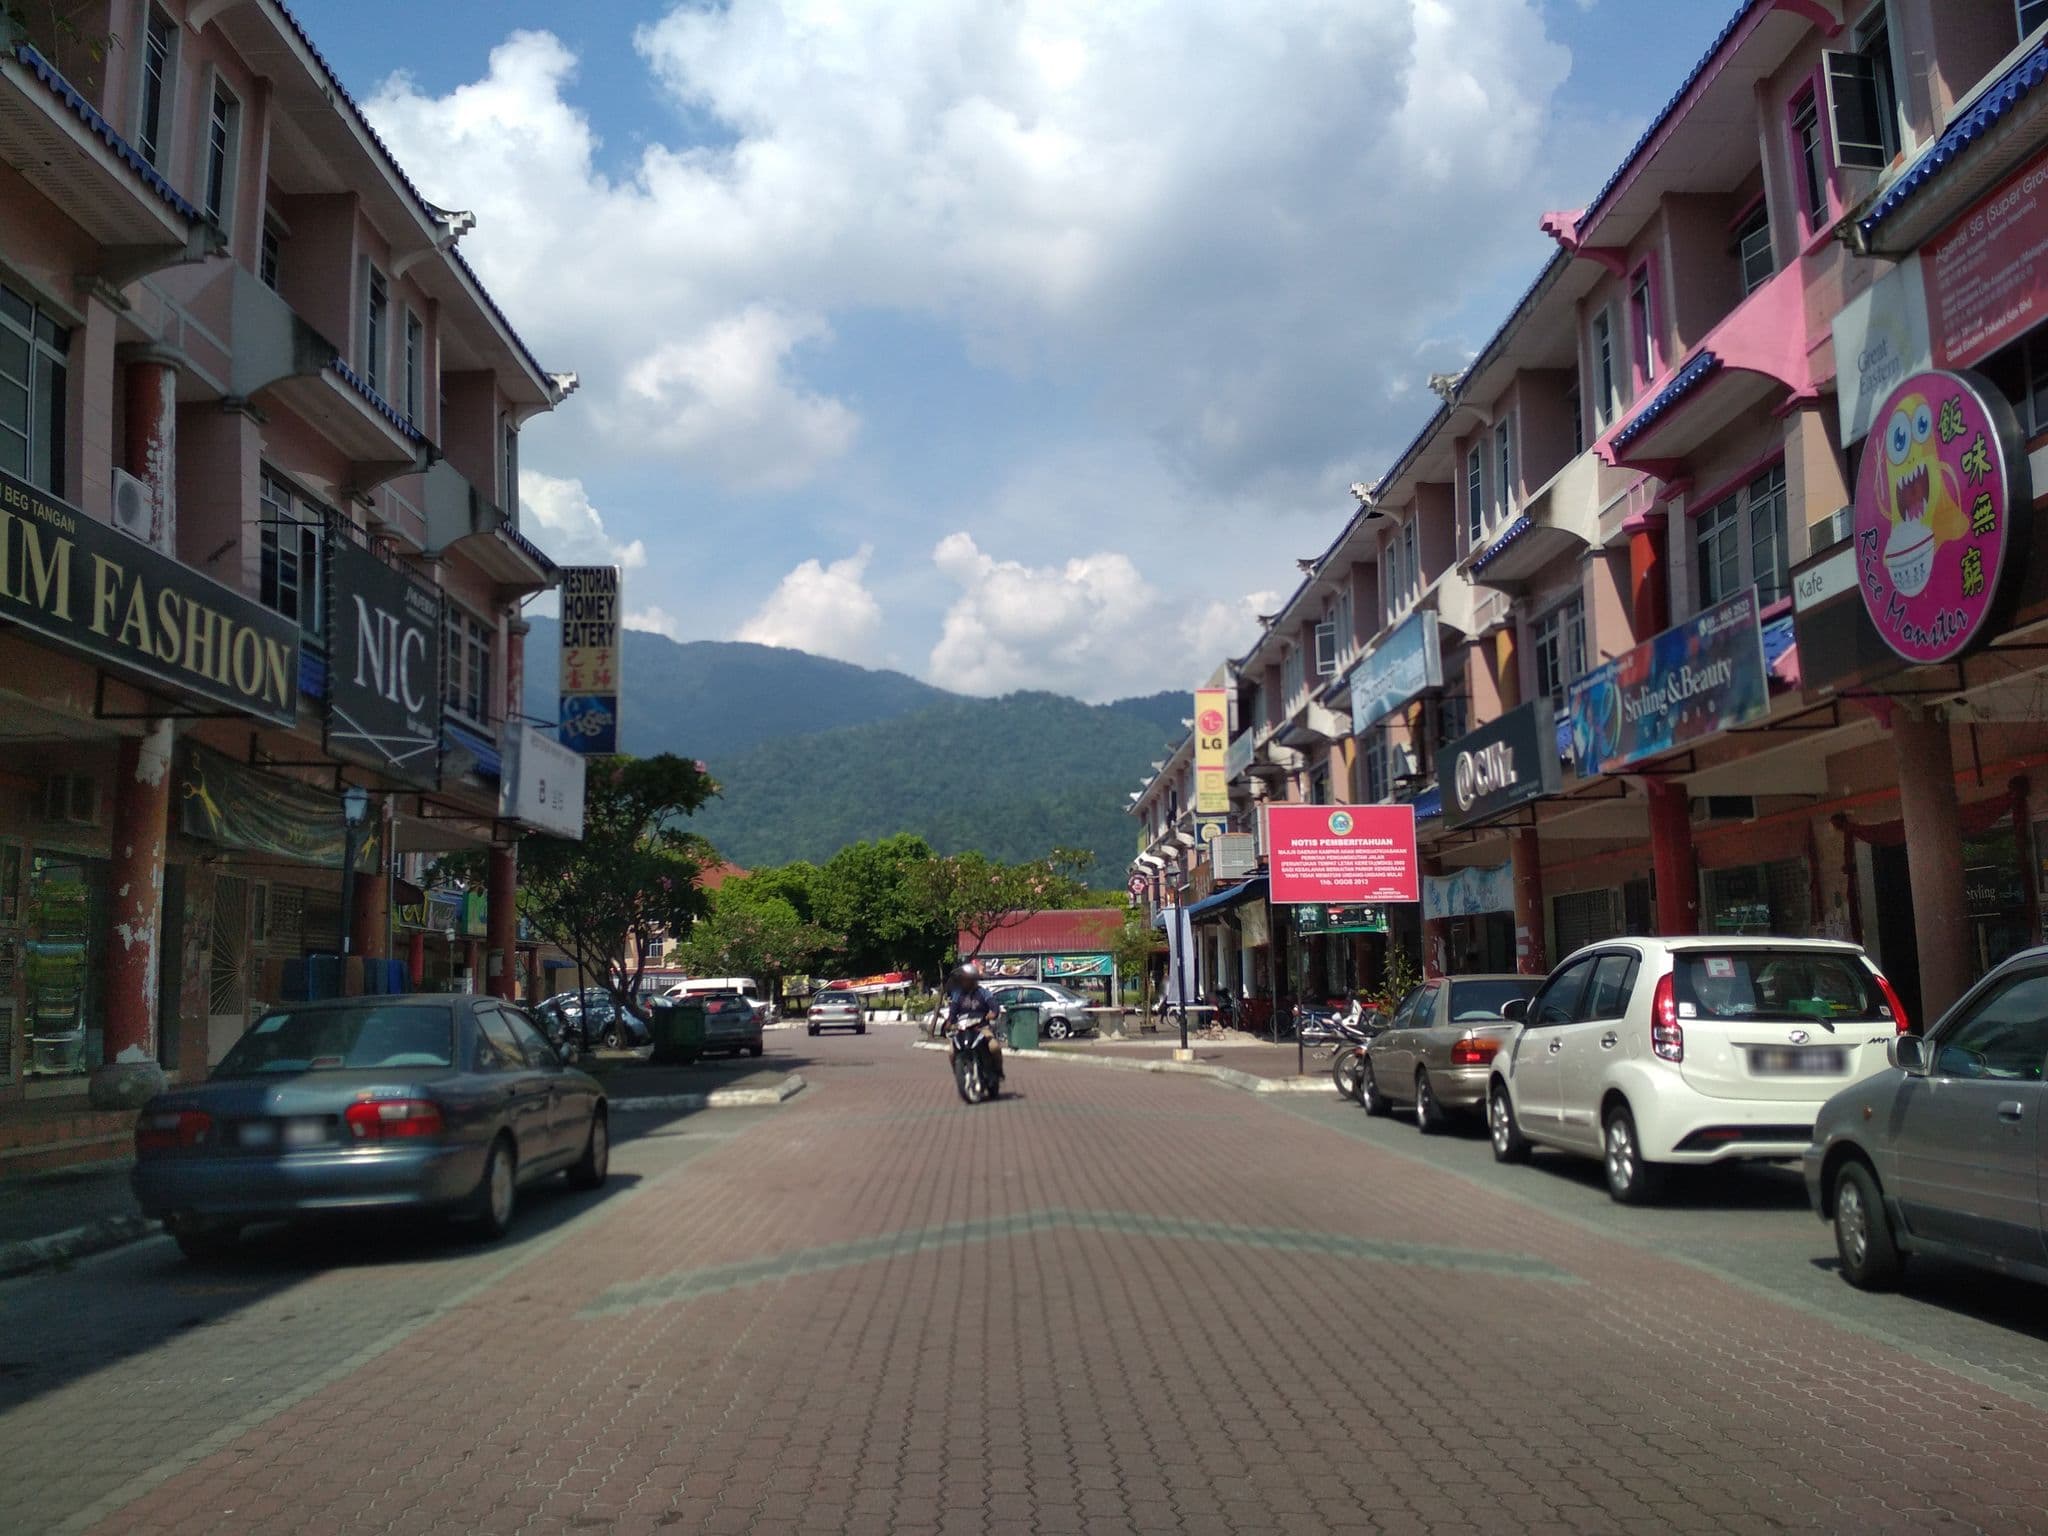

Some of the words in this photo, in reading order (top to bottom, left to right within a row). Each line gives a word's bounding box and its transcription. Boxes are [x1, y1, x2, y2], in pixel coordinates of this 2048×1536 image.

[1969, 214, 1985, 238] SG
[1987, 191, 2020, 226] (Super
[1857, 338, 1888, 374] Great
[1859, 355, 1900, 396] Eastern
[4, 486, 29, 512] BEG
[31, 499, 76, 535] TANGAN
[564, 568, 617, 594] RESTORAN
[1798, 573, 1825, 600] Kafe
[1860, 528, 1886, 602] Rice
[1885, 590, 1969, 648] Monster
[564, 595, 617, 623] HOMEY
[88, 551, 291, 710] FASHION
[563, 622, 616, 649] EATERY
[352, 593, 427, 714] NIC
[1624, 685, 1668, 724] Styling
[1680, 657, 1732, 697] Beauty
[565, 708, 614, 738] Tiger
[1202, 738, 1222, 750] LG
[1291, 838, 1318, 847] NOTIS
[1320, 838, 1393, 846] PEMBERITAHUAN
